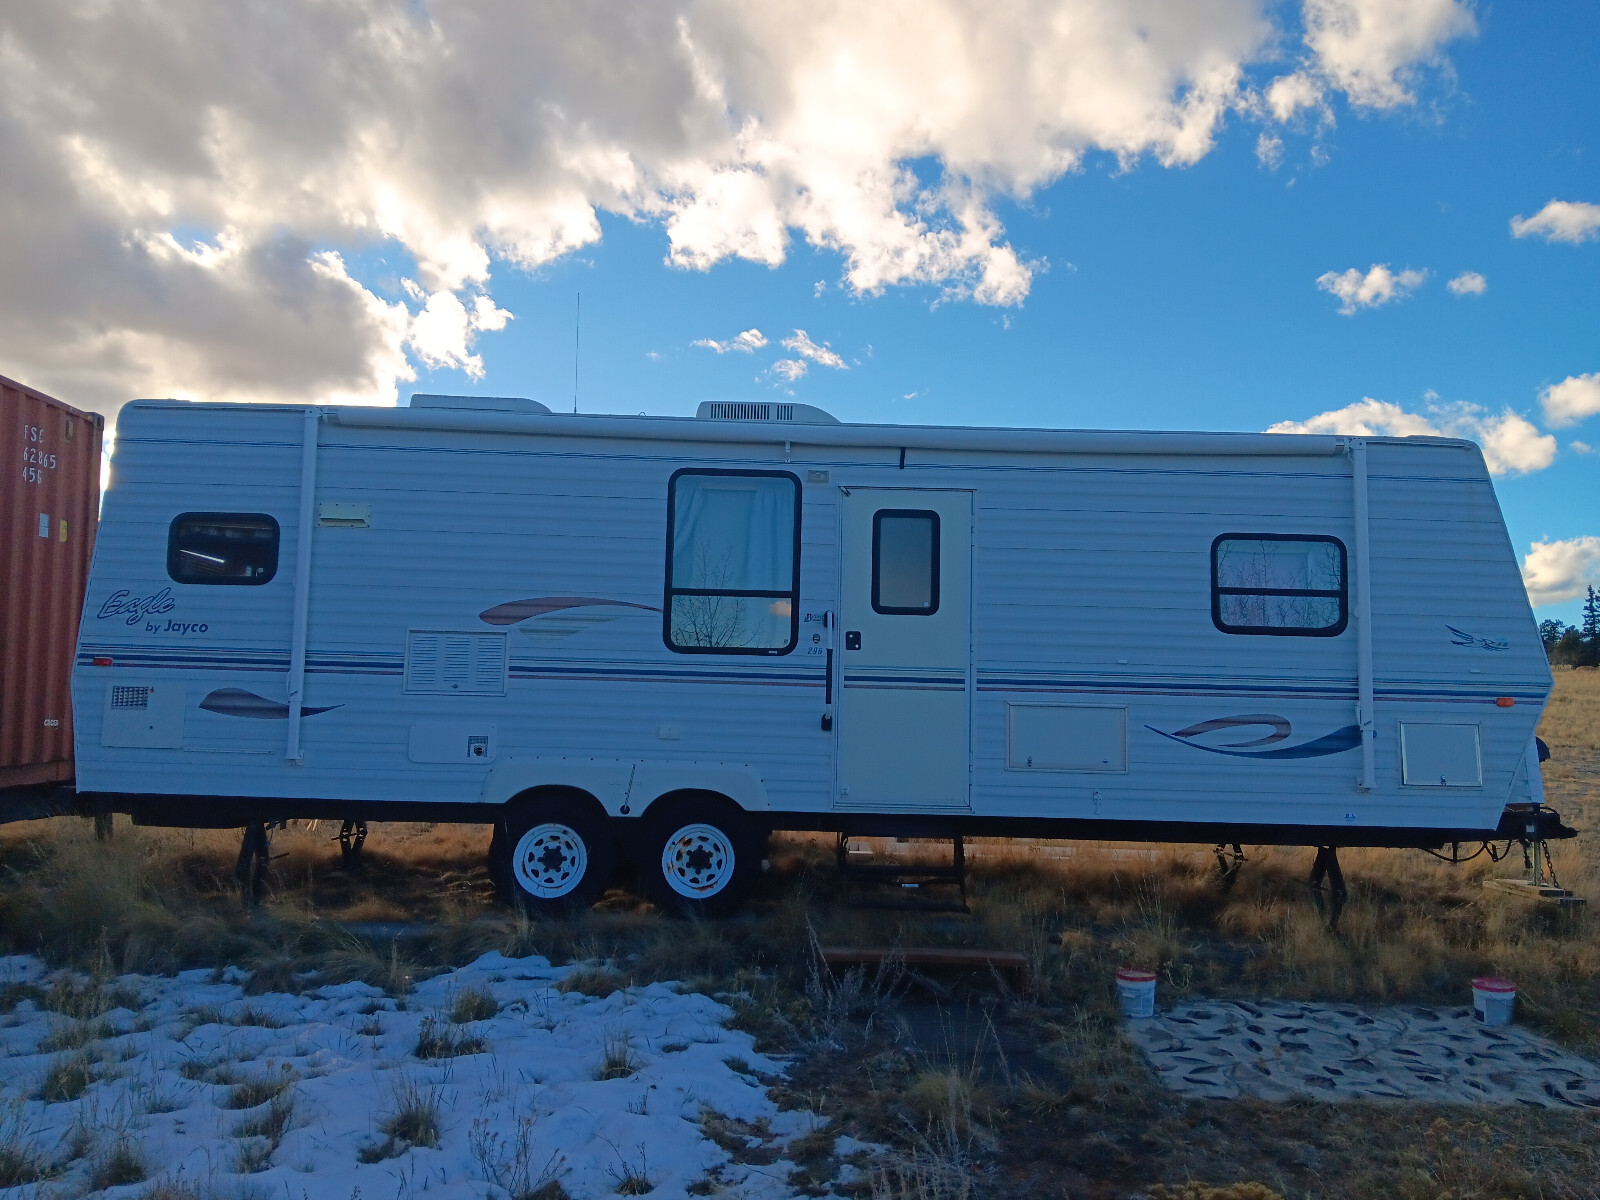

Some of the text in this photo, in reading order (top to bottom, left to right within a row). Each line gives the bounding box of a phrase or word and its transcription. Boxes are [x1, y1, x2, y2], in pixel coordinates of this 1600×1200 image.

[23, 446, 56, 469] 62865
[97, 587, 175, 625] Eagle
[145, 619, 209, 636] by Jayco
